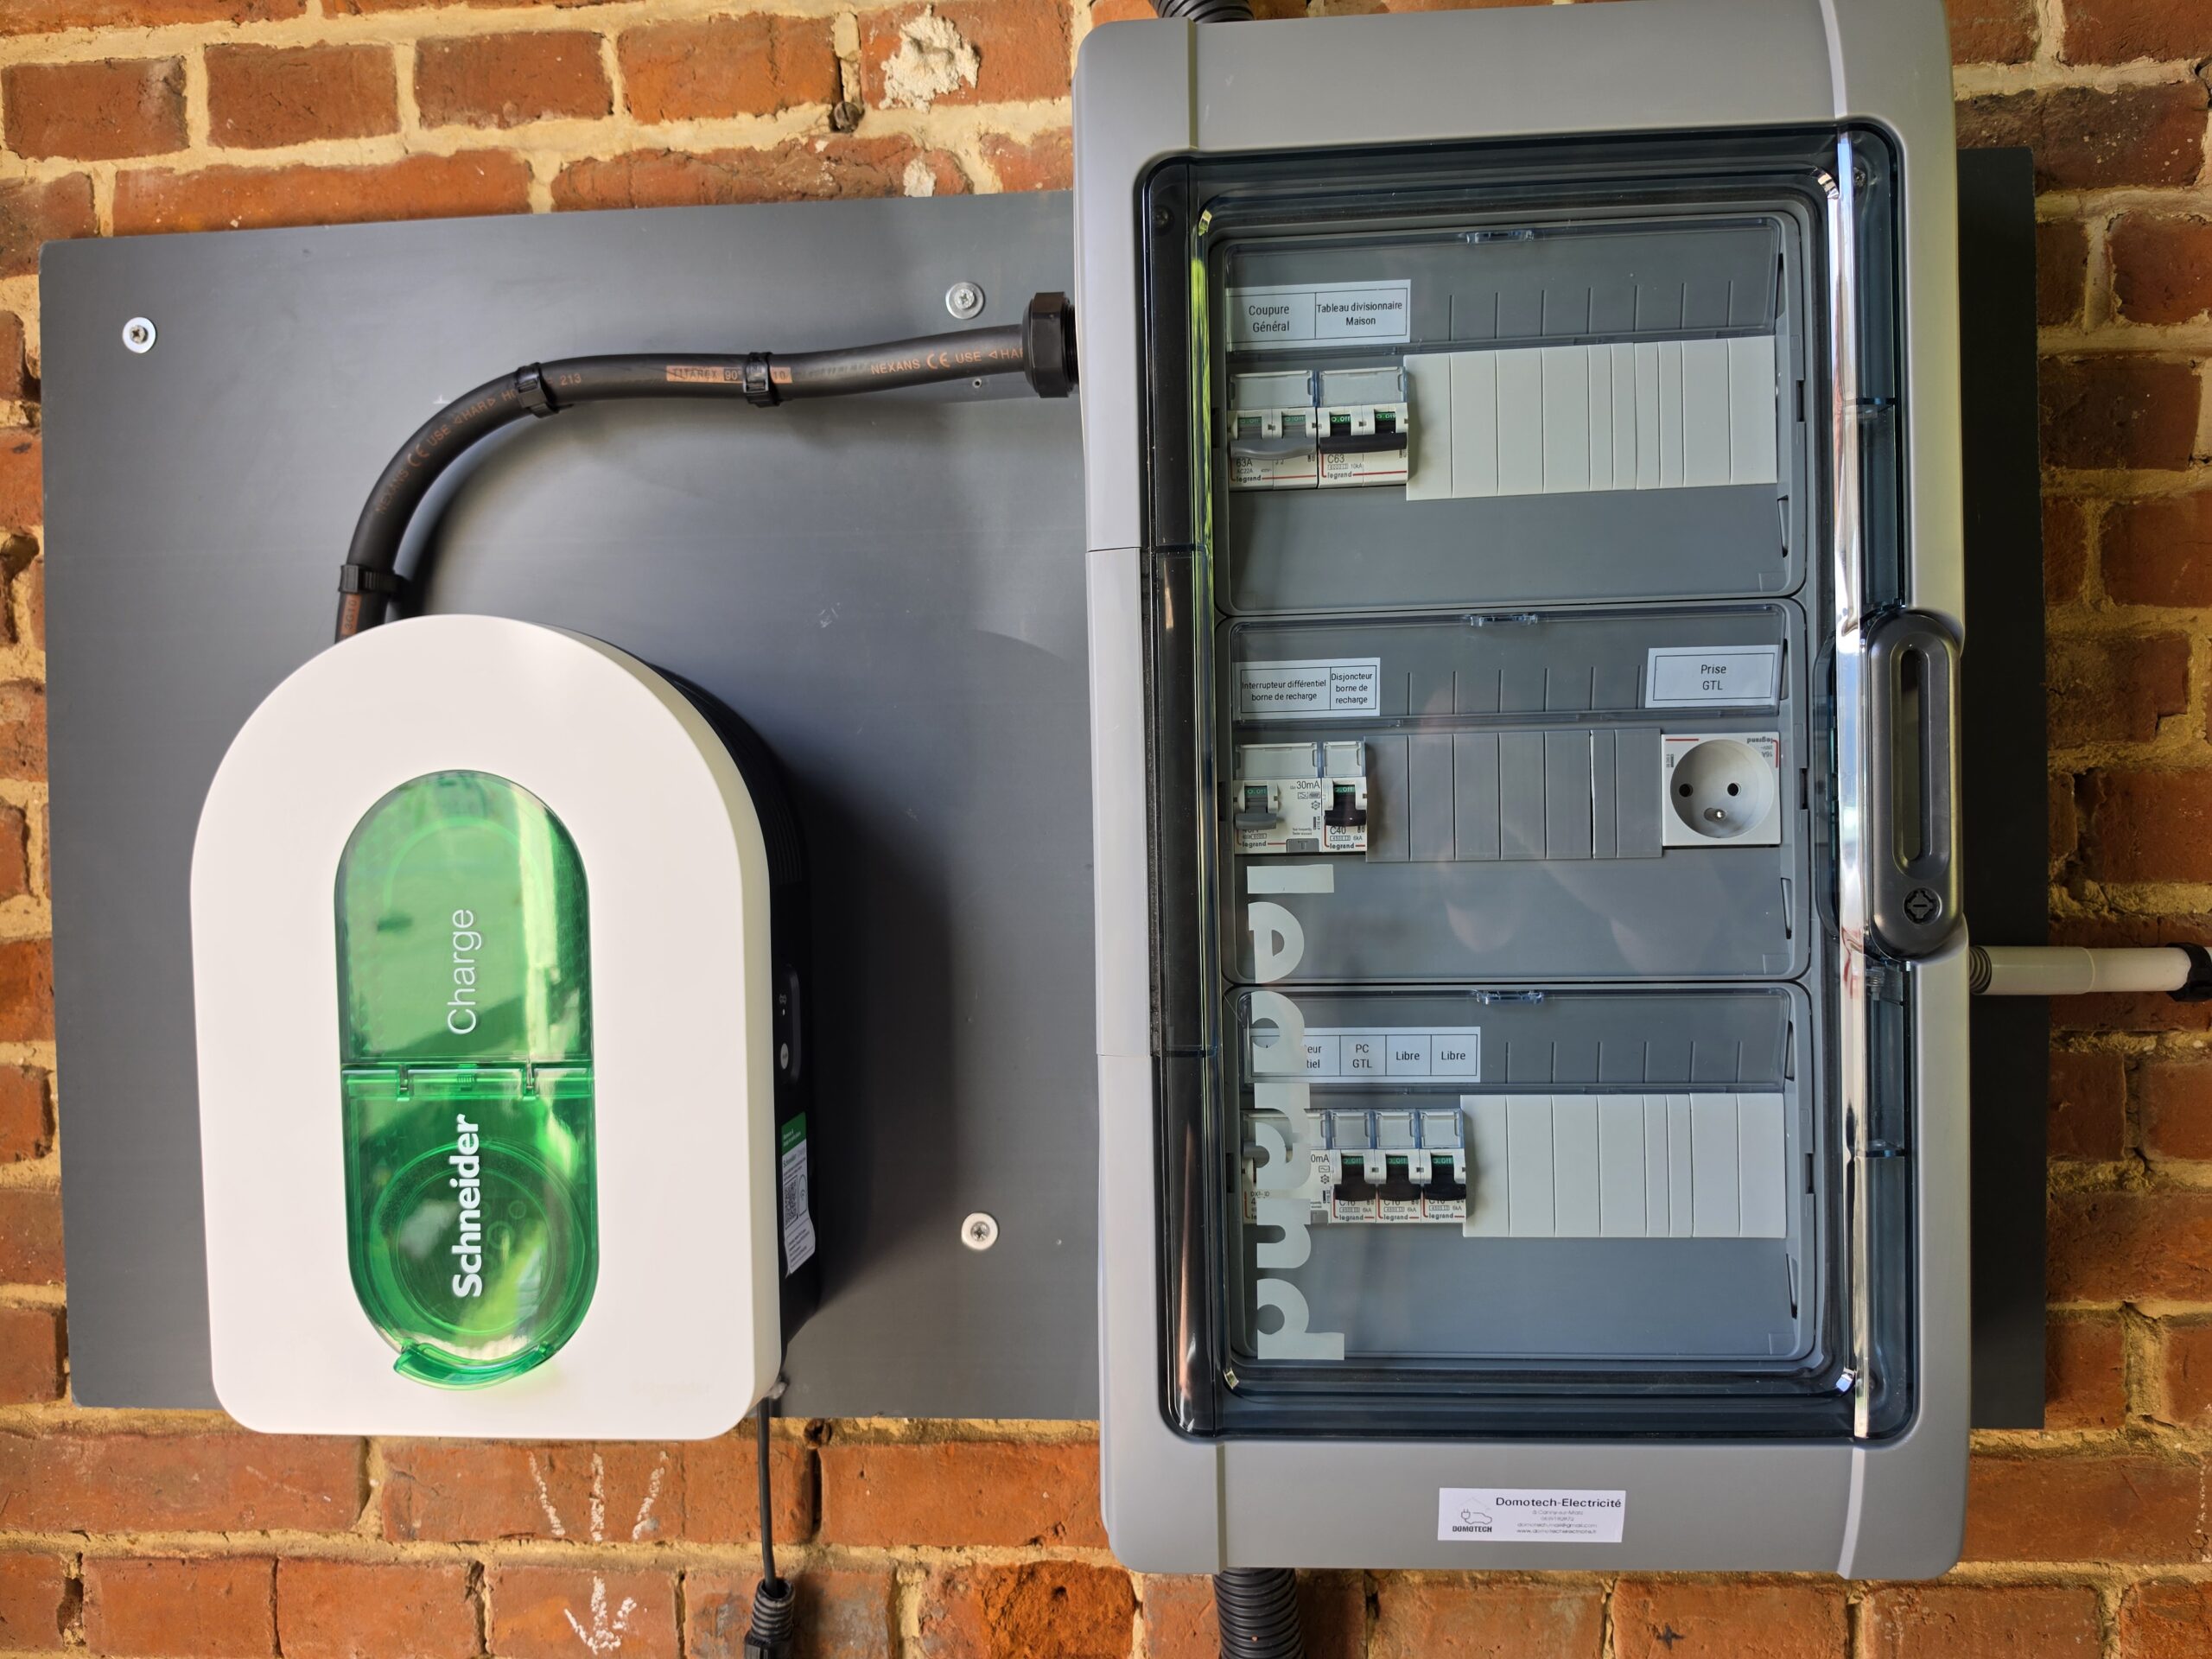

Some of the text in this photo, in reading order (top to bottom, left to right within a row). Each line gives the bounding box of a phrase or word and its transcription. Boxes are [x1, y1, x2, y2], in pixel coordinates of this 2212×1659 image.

[1249, 305, 1290, 317] Coupure
[1317, 302, 1403, 314] Tableau divisionnaire
[1252, 321, 1290, 333] Général
[1345, 317, 1376, 327] Maison
[870, 359, 920, 375] NEXANS
[955, 352, 982, 364] USE
[374, 468, 410, 515] NEXANS
[427, 424, 452, 447] USE
[561, 373, 582, 386] 213
[1327, 454, 1345, 464] C63
[1236, 474, 1262, 483] legrand
[1327, 471, 1352, 480] legrand
[1700, 664, 1726, 674] Prise
[1331, 672, 1372, 681] Disjoncteur
[1242, 679, 1326, 690] Interrupteur différentiel
[1702, 681, 1723, 690] GTL
[1286, 692, 1318, 702] recharge
[1336, 696, 1368, 704] recharge
[1296, 780, 1320, 790] 30mA
[447, 909, 482, 1035] Charge
[1356, 1044, 1369, 1053] PC
[1395, 1051, 1421, 1061] Libre
[1441, 1050, 1466, 1061] Libre
[1352, 1059, 1372, 1069] GTL
[1248, 865, 1344, 1360] legrand
[448, 1113, 482, 1298] Schneider
[1496, 1497, 1622, 1509] Domotech-Electricité
